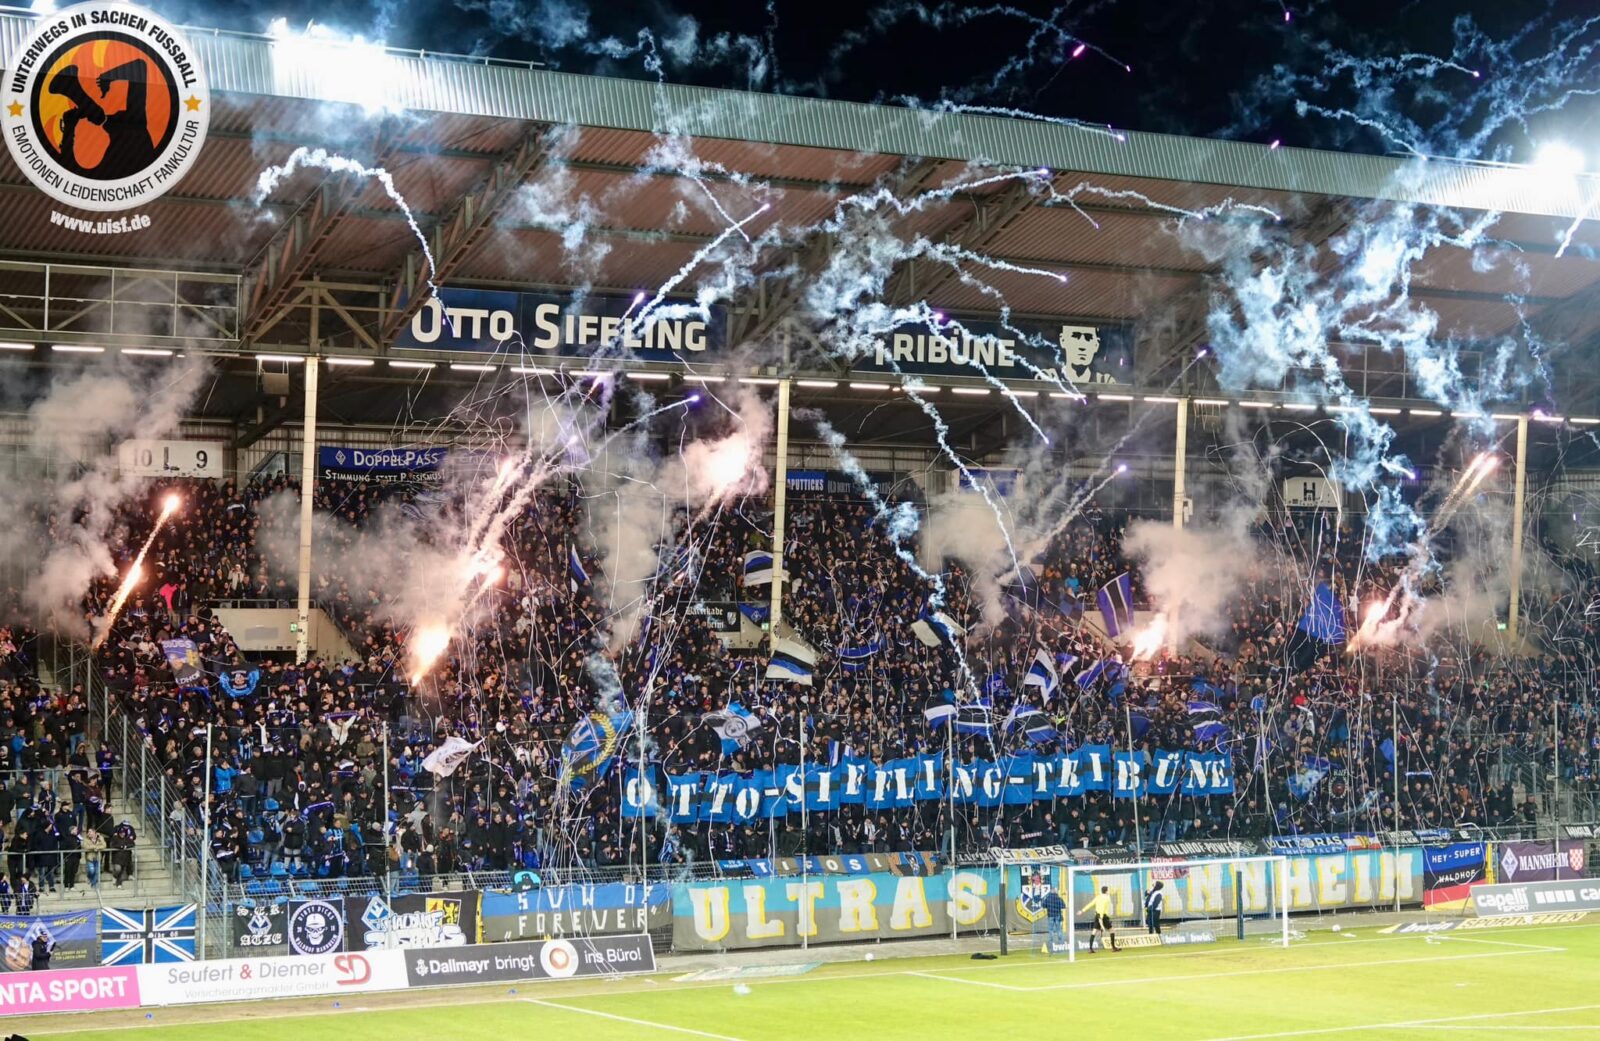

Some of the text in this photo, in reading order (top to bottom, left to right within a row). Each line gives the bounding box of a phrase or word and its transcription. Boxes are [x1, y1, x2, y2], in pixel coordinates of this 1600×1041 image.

[196, 450, 208, 468] 9
[1303, 481, 1316, 501] H
[1454, 846, 1480, 859] SUPER
[689, 872, 988, 941] ULTRAS
[1477, 887, 1528, 911] capelli
[429, 946, 642, 975] Dallmayr bringt ins Büro!
[168, 964, 233, 984] Seufert
[240, 963, 252, 979] &
[259, 962, 326, 978] Diemer
[49, 976, 128, 1001] SPORT
